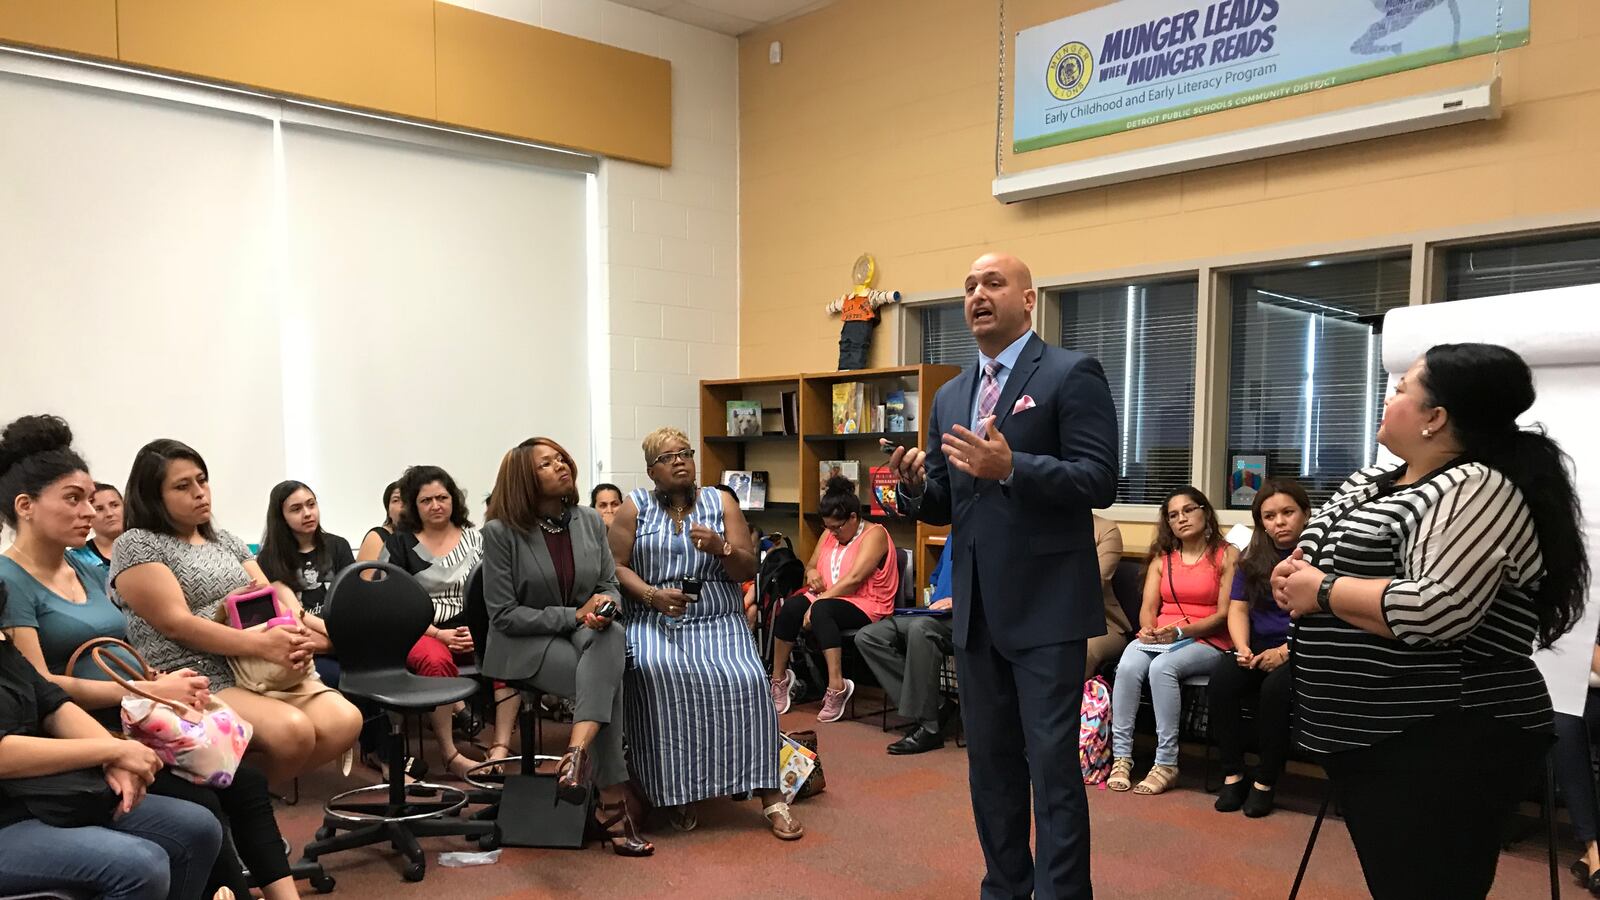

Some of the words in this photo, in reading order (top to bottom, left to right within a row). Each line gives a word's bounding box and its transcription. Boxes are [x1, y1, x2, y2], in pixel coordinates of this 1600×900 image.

[1050, 44, 1090, 70] MUNGER
[1099, 10, 1199, 65] MUNGER
[1203, 0, 1279, 38] LEADS
[1099, 62, 1128, 82] WHEN
[1127, 43, 1207, 85] MUNGER
[1209, 25, 1277, 65] READS
[1045, 110, 1068, 125] Early
[1070, 99, 1123, 119] Childhood
[1125, 91, 1146, 106] and
[1148, 84, 1175, 101] Early
[1177, 75, 1222, 95] Literacy
[1225, 63, 1277, 83] Program
[1055, 82, 1084, 98] LIONS
[1126, 115, 1159, 129] DETROIT
[1162, 109, 1191, 124] PUBLIC
[1193, 100, 1233, 115] SCHOOLS
[1235, 88, 1291, 106] COMMUNITY
[1293, 77, 1337, 94] DISTRICT
